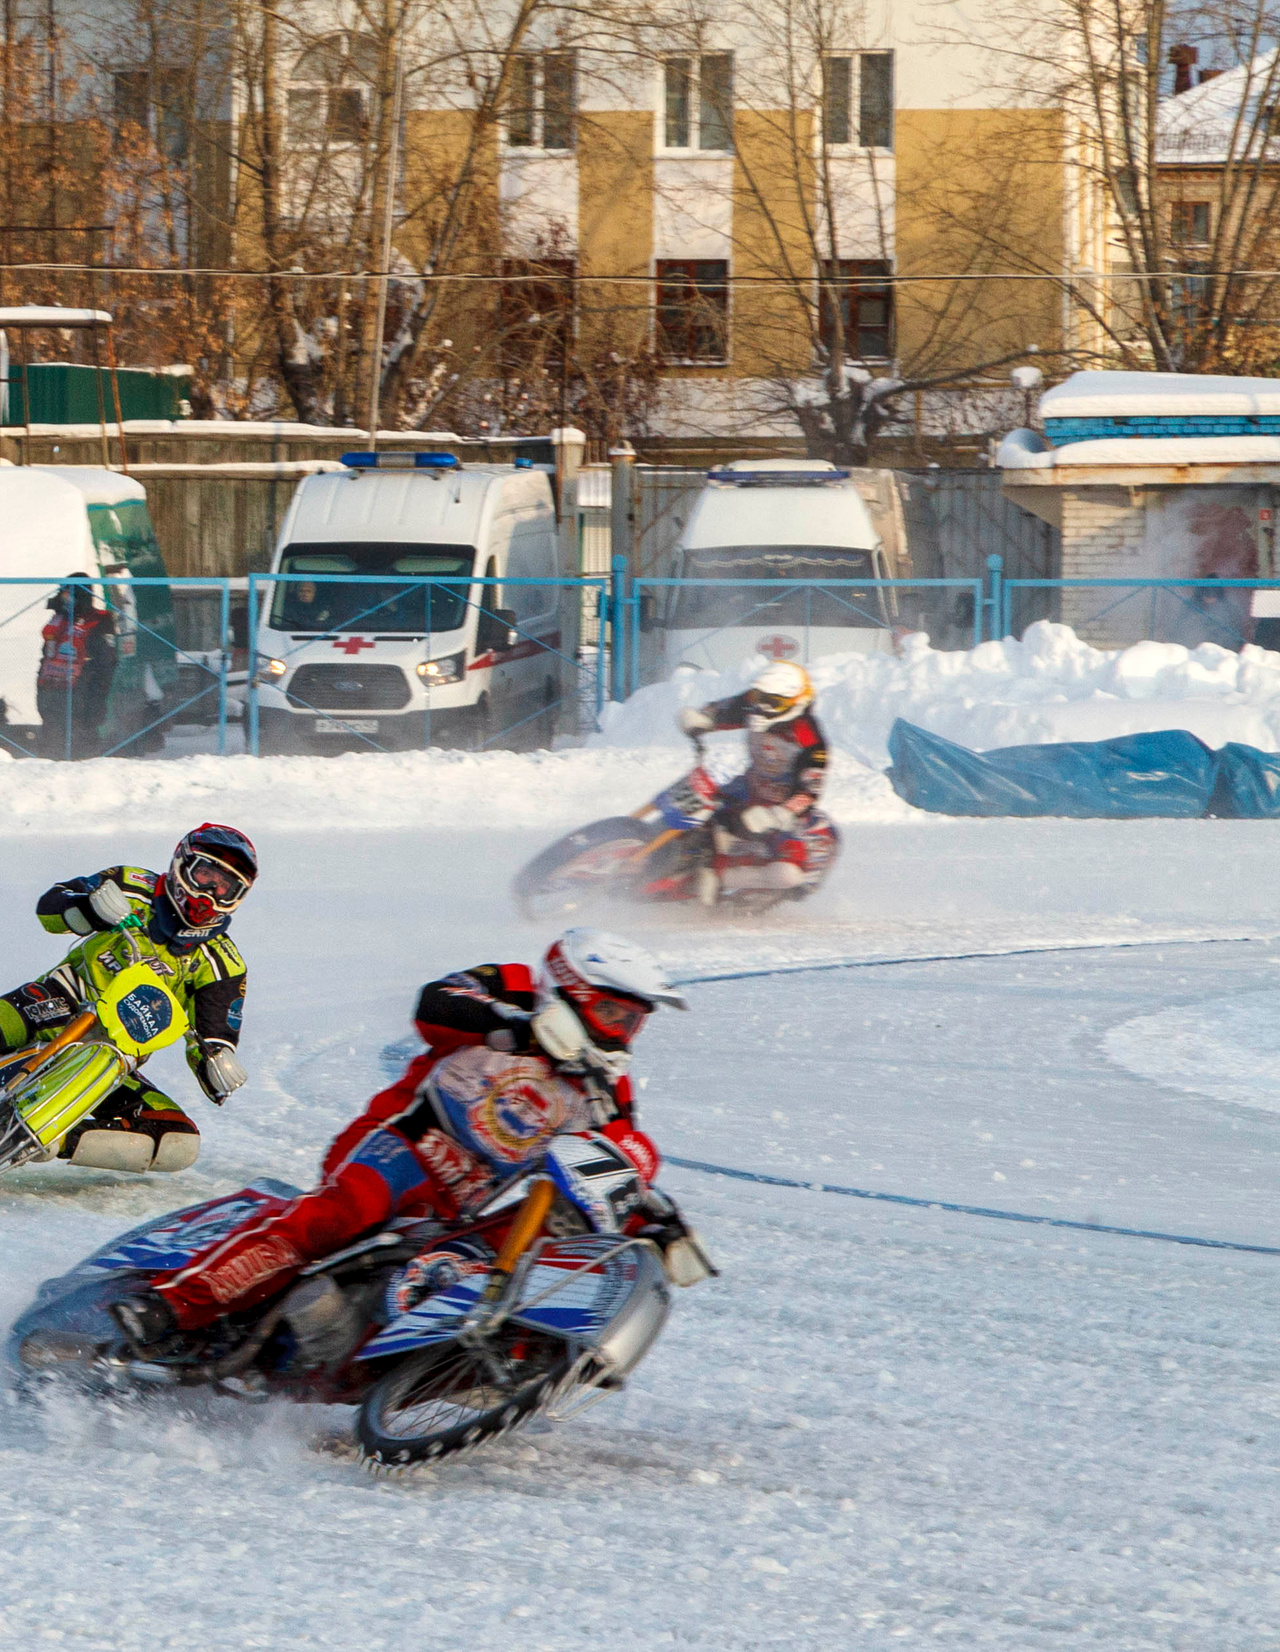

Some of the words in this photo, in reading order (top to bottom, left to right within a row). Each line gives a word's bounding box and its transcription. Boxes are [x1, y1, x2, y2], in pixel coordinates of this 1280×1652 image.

[177, 928, 213, 938] LEATT
[123, 999, 153, 1038] СУДОРЕМОНТ
[127, 993, 159, 1036] БАЙКАЛ
